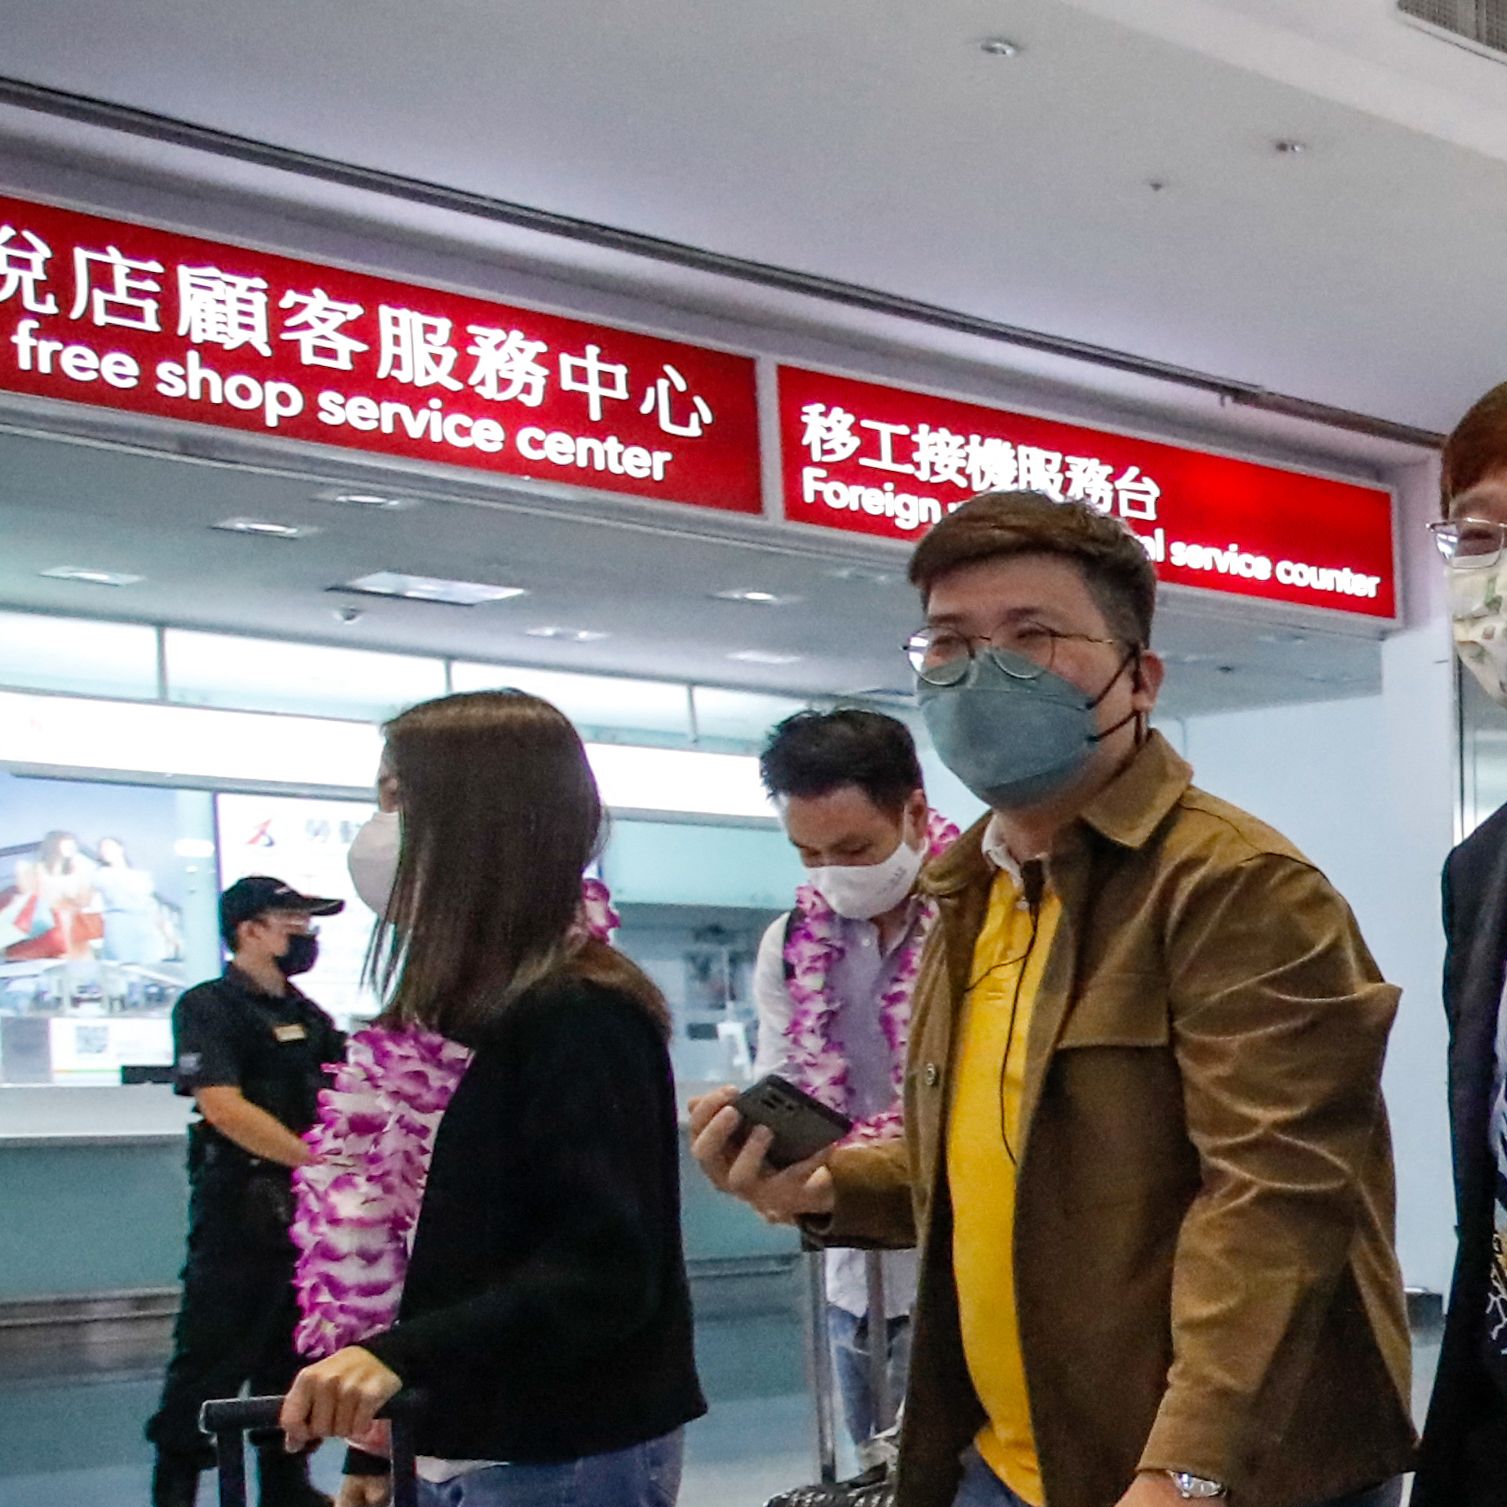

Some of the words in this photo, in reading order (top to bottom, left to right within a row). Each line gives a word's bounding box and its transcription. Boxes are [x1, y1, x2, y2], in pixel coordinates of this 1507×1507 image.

[10, 319, 140, 389] free
[156, 350, 304, 428] shop
[317, 391, 504, 453] service
[515, 427, 673, 482] center
[801, 402, 1161, 521] 移工接機服務台
[801, 467, 942, 530] Foreign
[1170, 541, 1272, 581] service
[1276, 560, 1381, 598] counter
